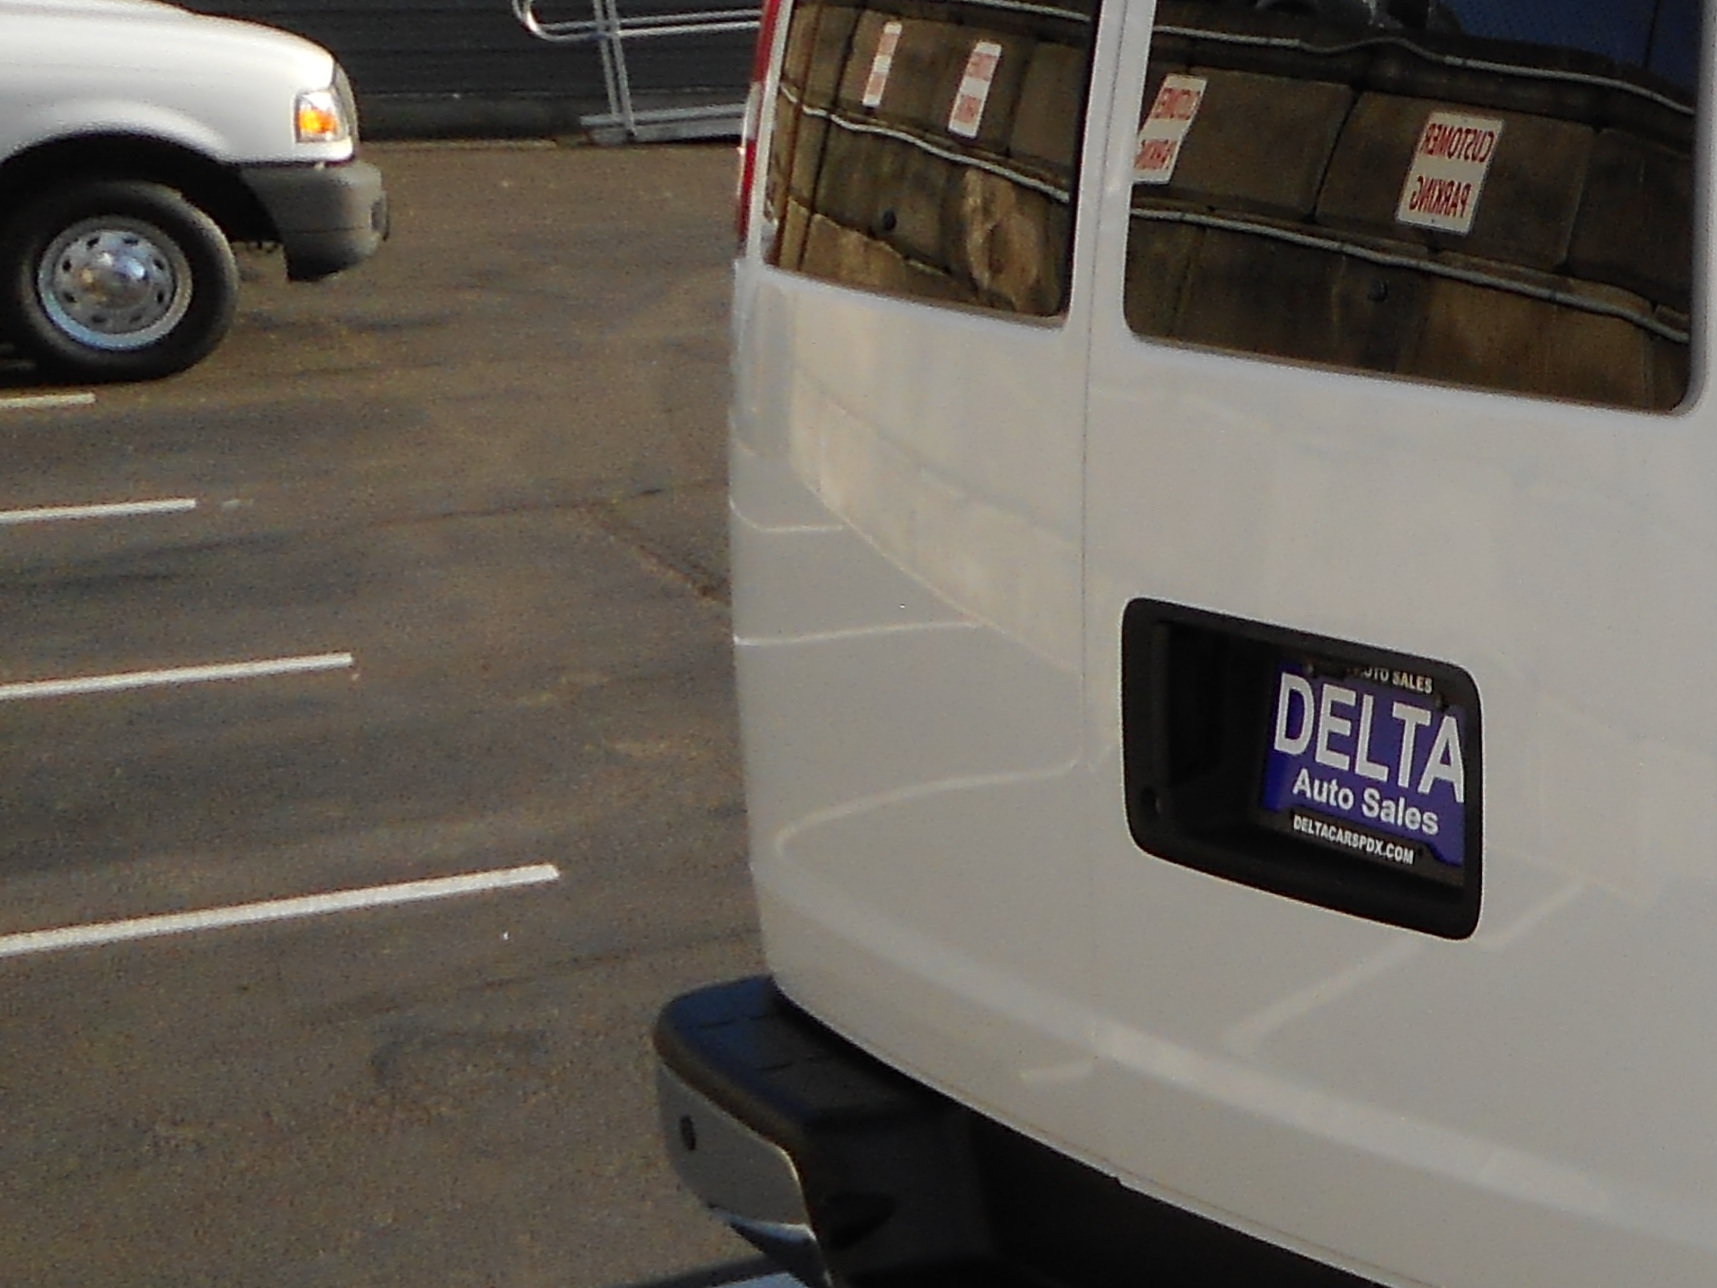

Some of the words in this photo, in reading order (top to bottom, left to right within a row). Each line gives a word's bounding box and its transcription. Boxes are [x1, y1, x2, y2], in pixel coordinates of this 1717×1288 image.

[1361, 667, 1390, 683] UTO
[1391, 670, 1433, 695] SALES
[1273, 671, 1465, 804] DELTA
[1292, 767, 1355, 811] Auto
[1361, 786, 1440, 836] Sales
[1293, 814, 1415, 865] DELTACARSPDX.COM
